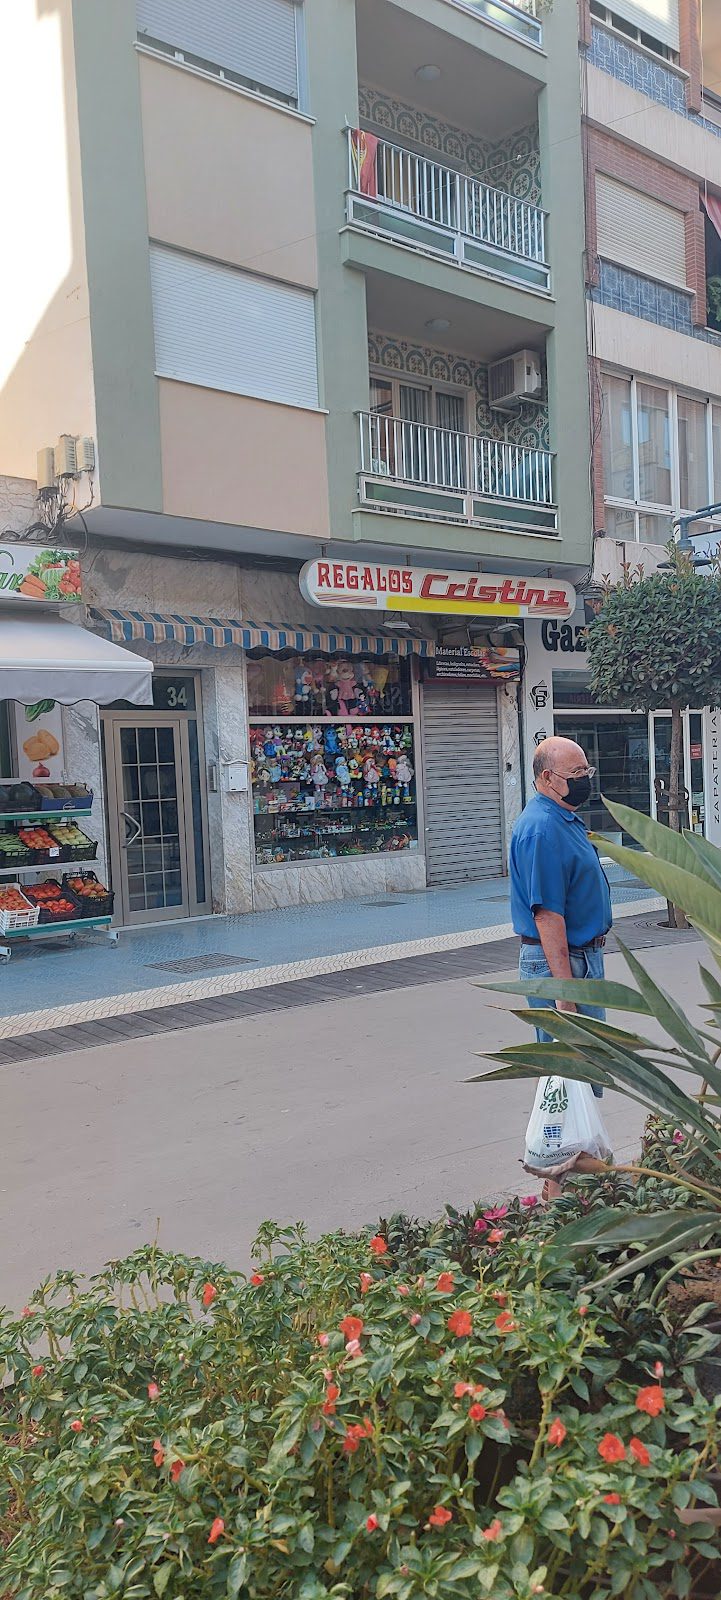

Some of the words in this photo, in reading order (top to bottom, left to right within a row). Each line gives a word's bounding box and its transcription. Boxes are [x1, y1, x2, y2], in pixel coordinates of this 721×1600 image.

[317, 562, 413, 594] REGALOS
[420, 573, 569, 608] Cristina
[436, 646, 463, 656] Material
[167, 686, 188, 707] 34
